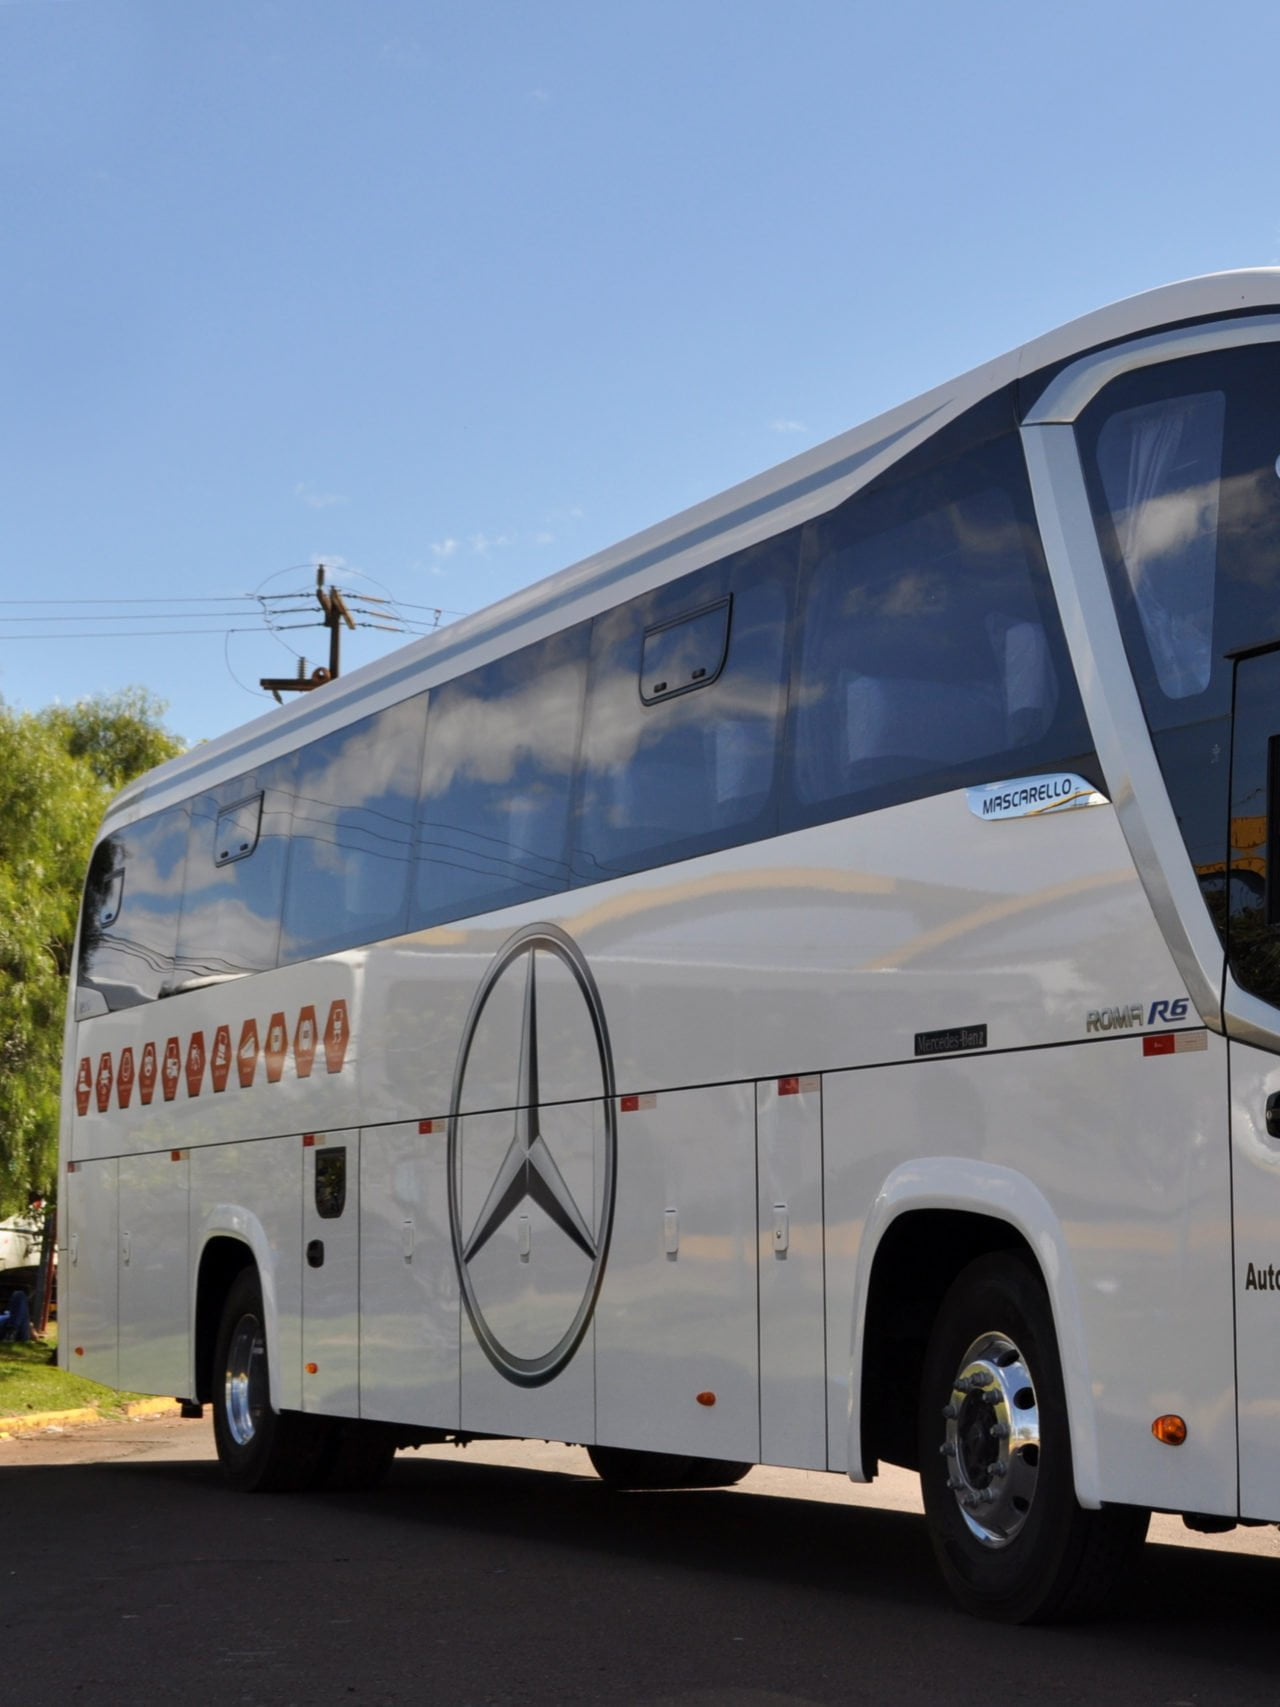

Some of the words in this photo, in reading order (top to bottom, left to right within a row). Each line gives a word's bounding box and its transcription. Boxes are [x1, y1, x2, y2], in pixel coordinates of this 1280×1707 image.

[982, 778, 1072, 815] MASCARELLO
[1086, 1003, 1143, 1033] ROMA
[1147, 998, 1189, 1025] R6
[917, 1029, 985, 1053] Mercedes-Benz
